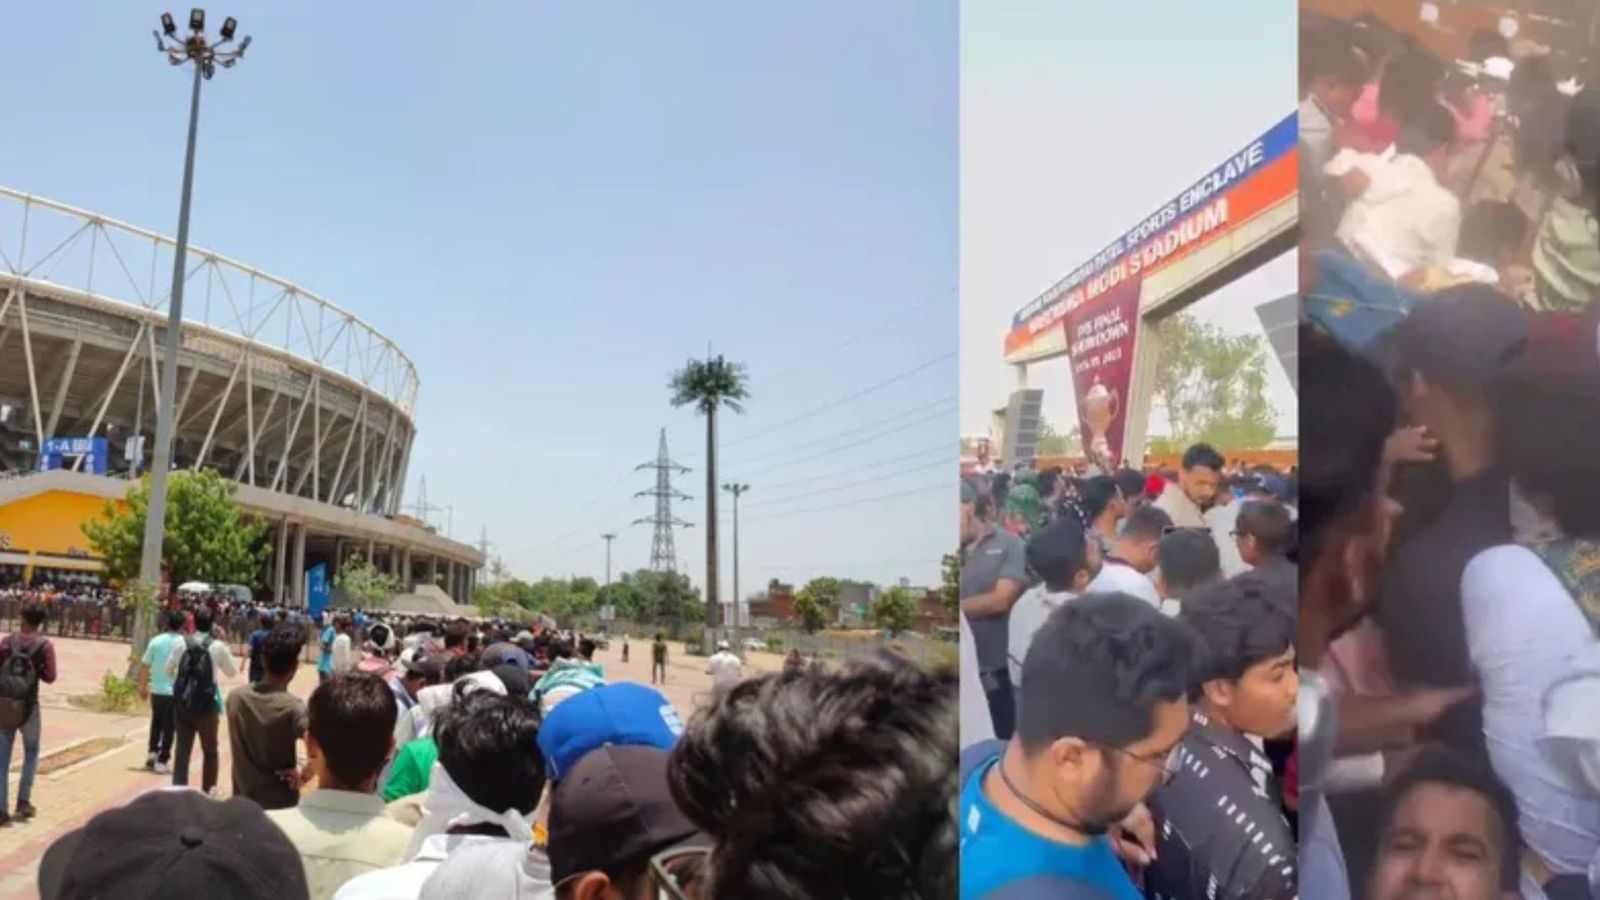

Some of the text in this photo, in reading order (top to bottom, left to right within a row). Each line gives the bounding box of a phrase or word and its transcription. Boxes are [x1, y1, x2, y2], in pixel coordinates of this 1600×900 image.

[1125, 201, 1178, 246] SPORTS
[1179, 141, 1264, 213] ENCLAVE
[1129, 196, 1228, 275] STADIUM
